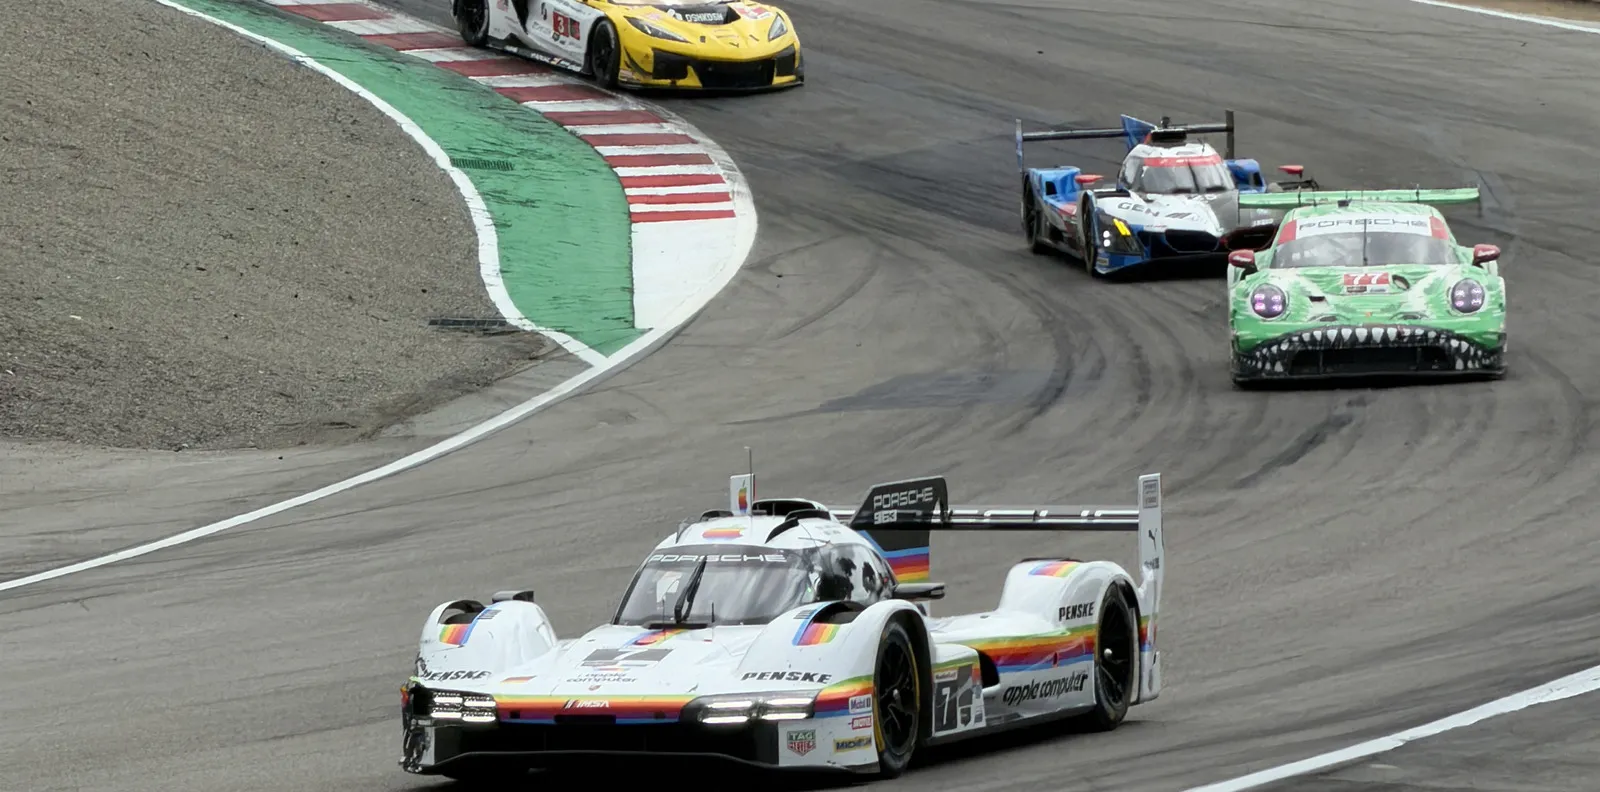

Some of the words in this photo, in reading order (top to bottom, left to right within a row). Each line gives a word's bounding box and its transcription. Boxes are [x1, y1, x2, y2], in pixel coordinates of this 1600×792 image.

[557, 16, 565, 34] 3
[685, 13, 723, 22] OSHKOSH
[1118, 202, 1160, 217] GEN
[1299, 218, 1428, 231] PORSCHE
[1346, 272, 1381, 285] 77
[874, 487, 933, 511] PORSCHE
[874, 510, 897, 525] 963
[648, 554, 787, 563] PORSCHE
[1059, 601, 1095, 622] PENSKE
[741, 671, 832, 684] PENSKE
[1003, 679, 1040, 706] apple
[1039, 671, 1088, 698] computer
[942, 687, 951, 725] 7
[790, 731, 814, 741] TAG
